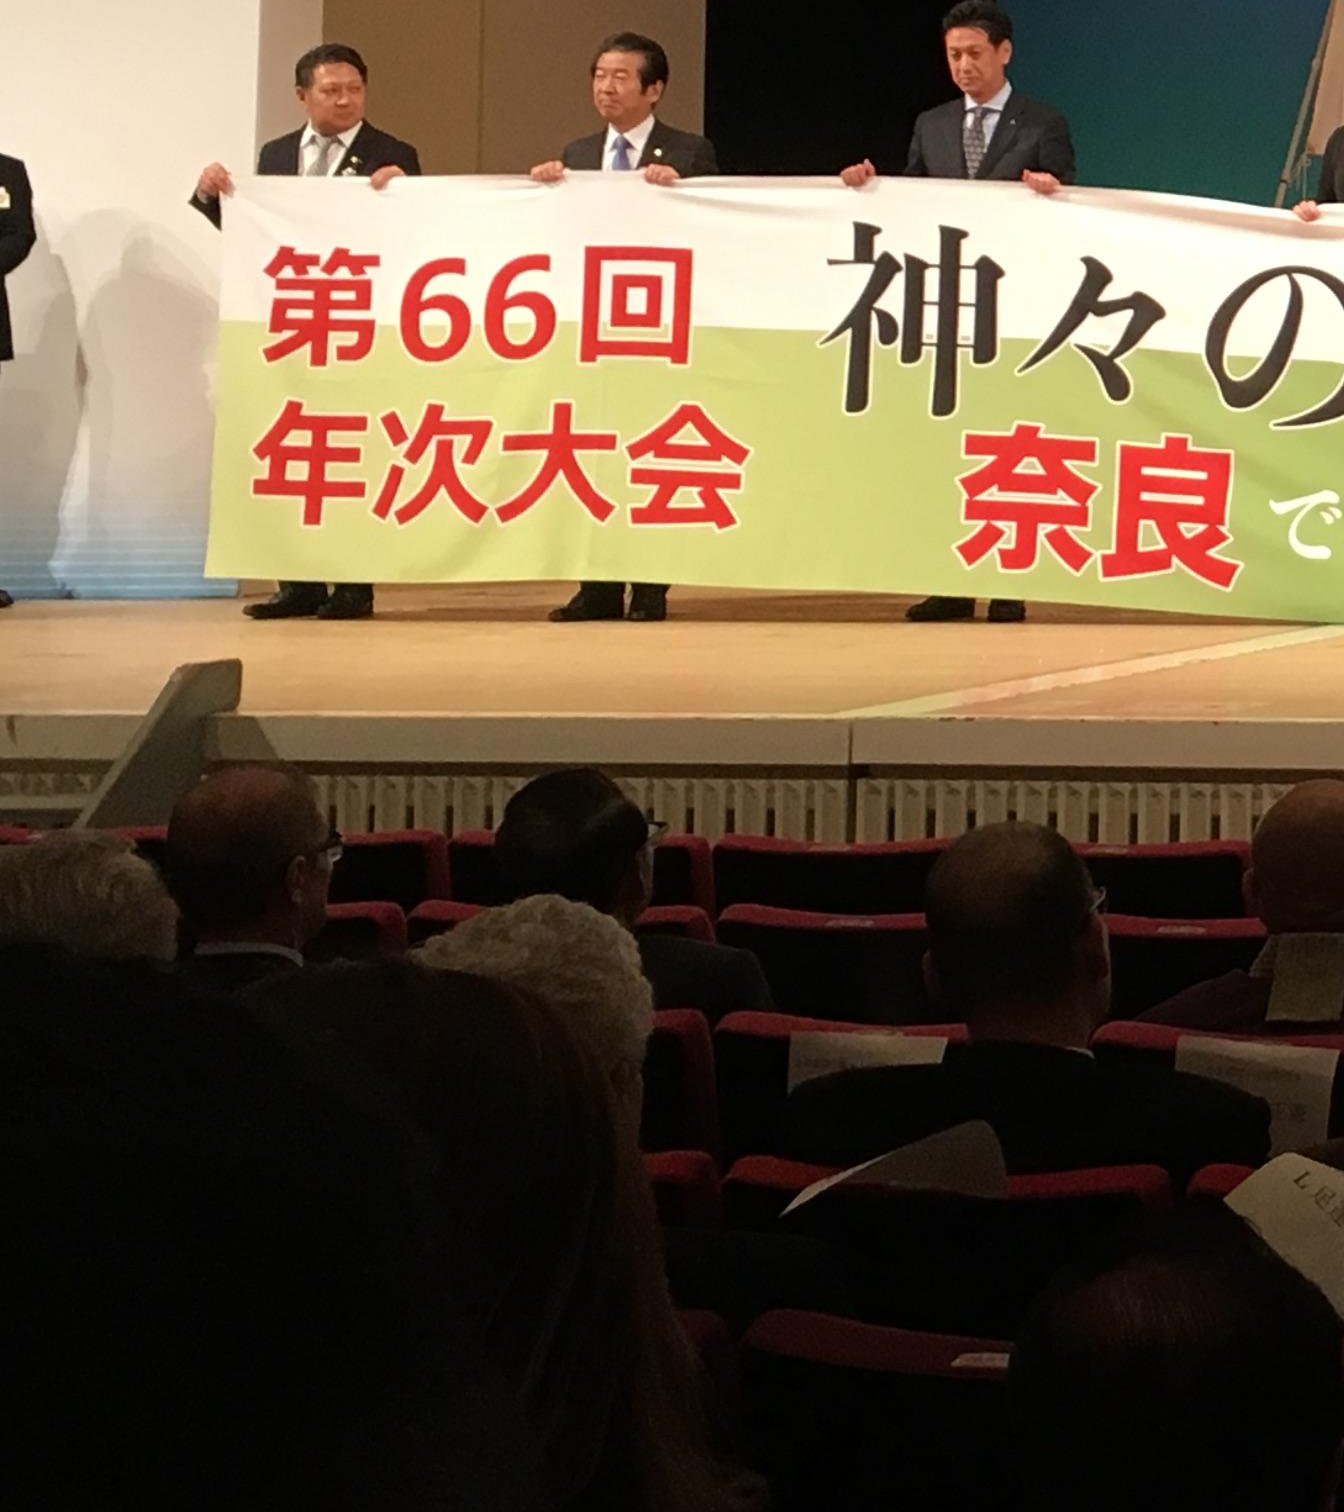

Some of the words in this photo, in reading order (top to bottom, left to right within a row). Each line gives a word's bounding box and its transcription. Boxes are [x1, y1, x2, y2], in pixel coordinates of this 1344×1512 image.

[260, 245, 694, 367] 第66回
[250, 399, 750, 532] 年次大会
